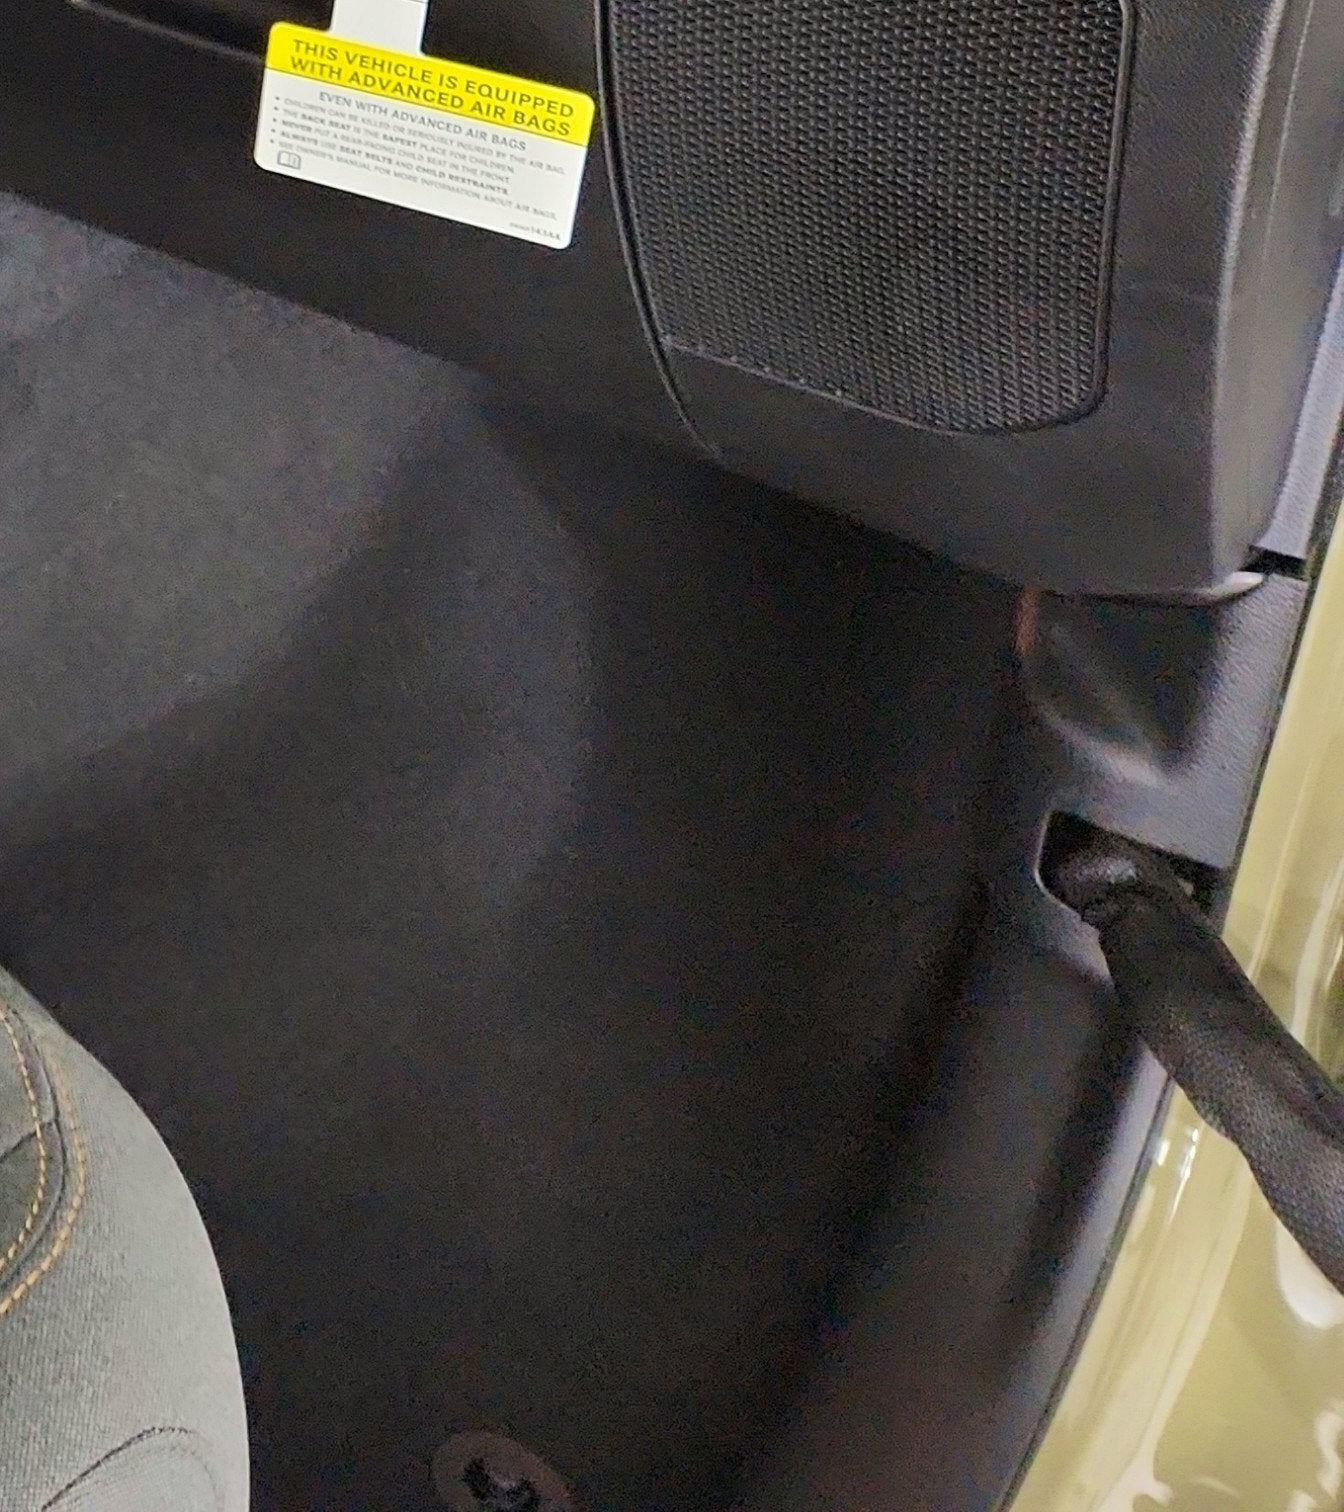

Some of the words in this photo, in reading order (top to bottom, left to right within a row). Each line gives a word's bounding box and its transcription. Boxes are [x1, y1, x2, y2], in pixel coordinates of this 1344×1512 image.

[289, 56, 343, 82] WITH
[347, 69, 465, 111] ADVANCED
[470, 98, 507, 121] AIR
[512, 108, 572, 137] BAGS
[292, 39, 338, 63] THIS
[343, 50, 433, 85] VEHICLE
[438, 71, 458, 90] IS
[464, 77, 575, 118] EQUIPPED
[319, 91, 351, 108] EVEN
[355, 100, 388, 117] WITH
[391, 109, 463, 135] ADVANCED
[465, 127, 488, 142] AIR
[491, 133, 527, 151] BAGS
